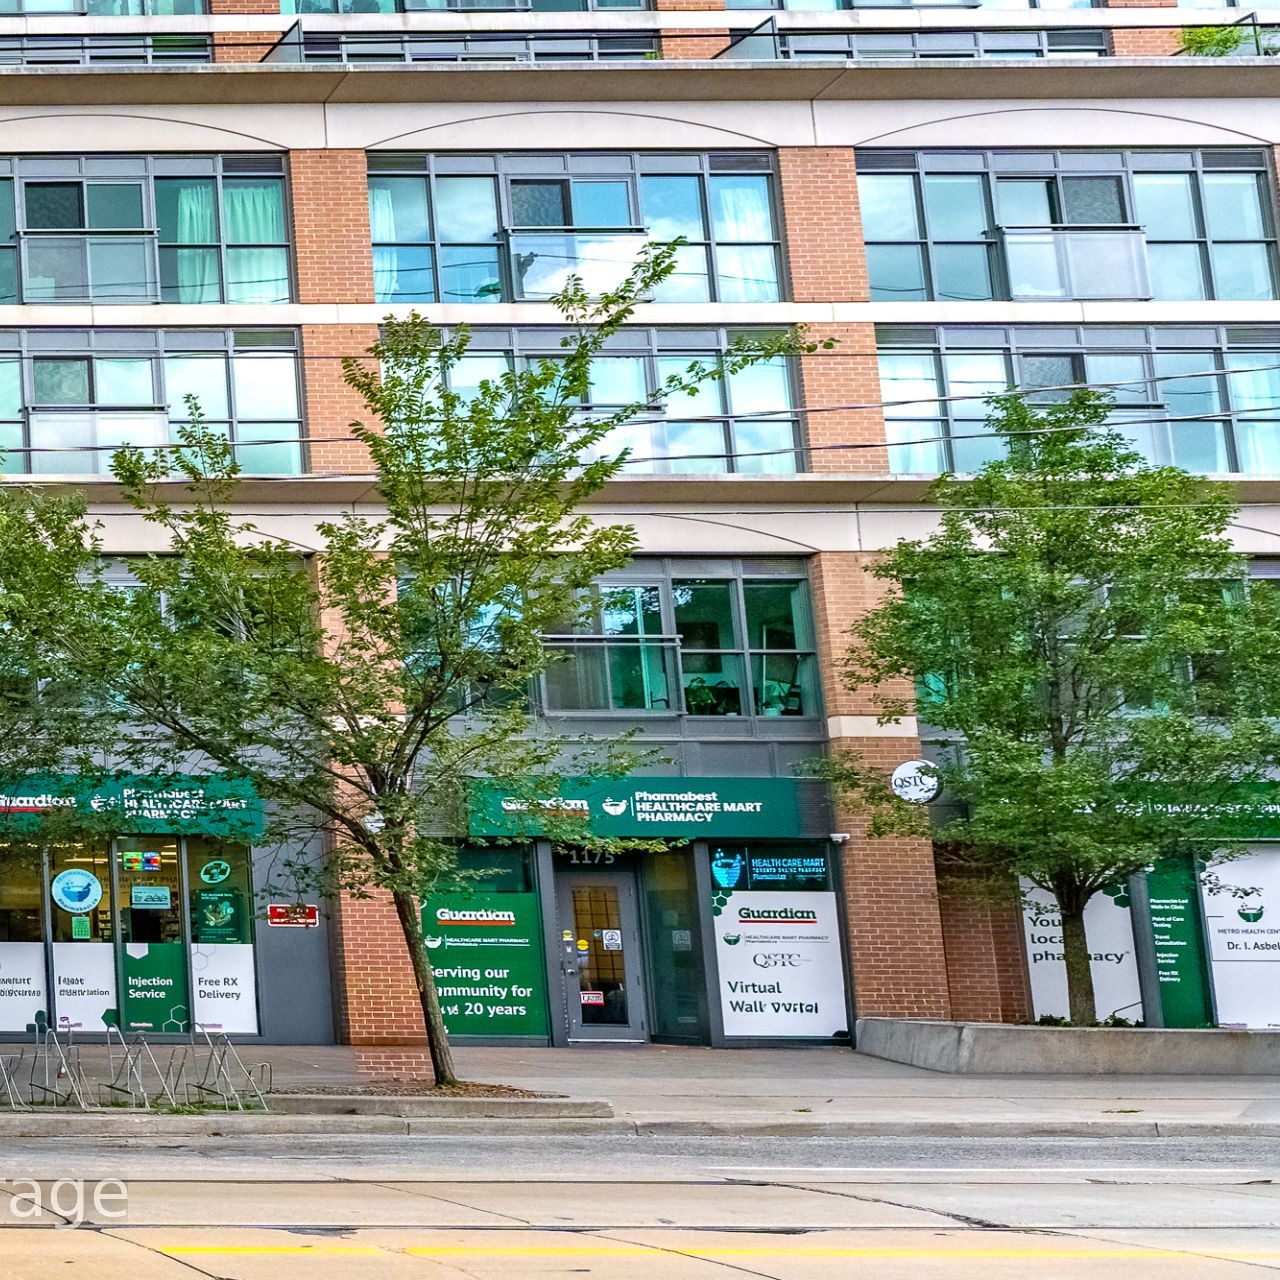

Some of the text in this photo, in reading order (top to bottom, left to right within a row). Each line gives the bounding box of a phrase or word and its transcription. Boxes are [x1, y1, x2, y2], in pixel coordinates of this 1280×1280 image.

[635, 791, 718, 802] Pharmabest
[636, 802, 763, 813] HEALTHCARE MART
[637, 812, 714, 823] PHARMACY
[569, 849, 615, 864] 1175
[751, 858, 825, 867] HEALTH CARE MART
[435, 907, 516, 921] Guardian
[738, 907, 817, 920] Guardian
[1028, 916, 1063, 927] You
[1030, 933, 1064, 944] loca
[1227, 941, 1241, 951] Dr.
[752, 952, 801, 968] QSTC
[1032, 950, 1124, 964] phaacy
[430, 965, 510, 980] Serving our
[128, 976, 173, 988] Injection
[198, 977, 239, 987] Free RX
[727, 980, 782, 994] Virtual
[128, 988, 166, 999] Service
[199, 989, 241, 1001] Delivery
[436, 984, 533, 999] mmunity for
[464, 1002, 484, 1015] 20
[487, 1005, 527, 1018] years
